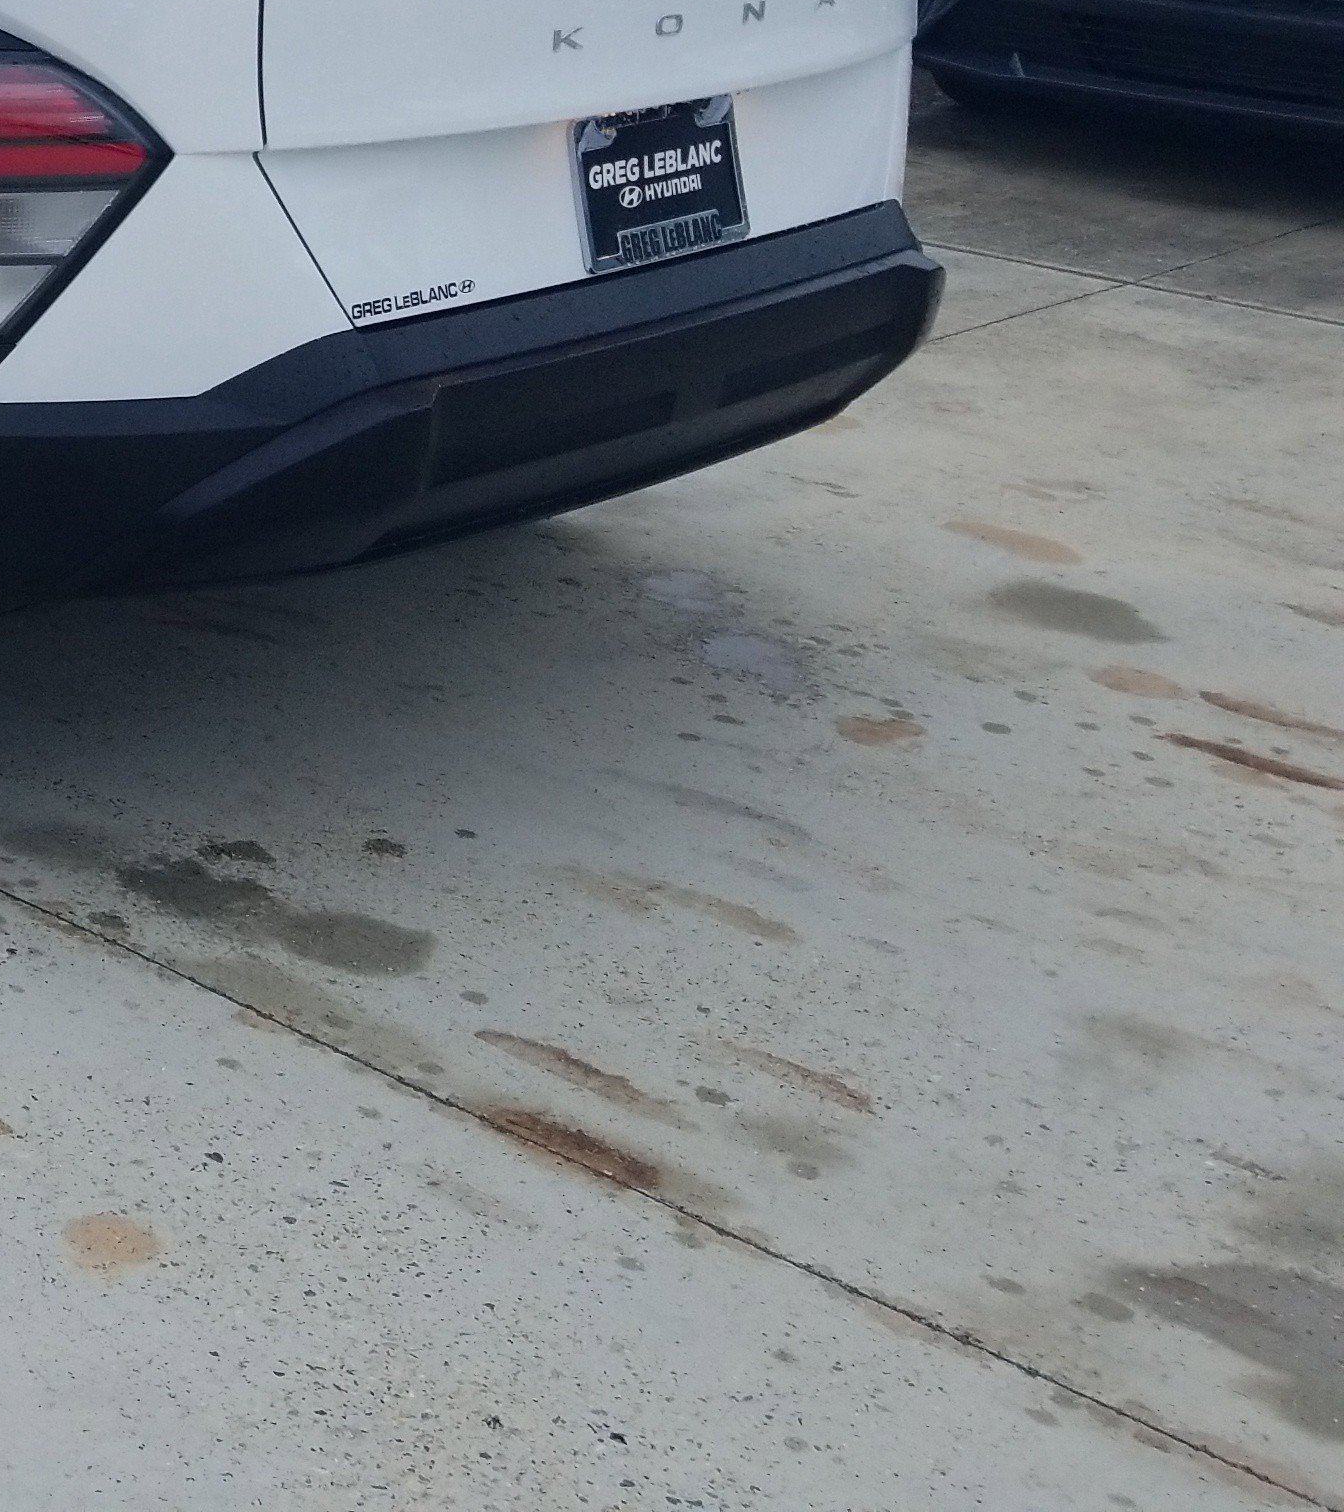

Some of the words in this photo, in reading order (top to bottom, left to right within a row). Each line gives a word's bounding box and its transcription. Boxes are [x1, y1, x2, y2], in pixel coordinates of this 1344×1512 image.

[589, 158, 640, 190] GREG
[643, 140, 722, 179] LEBLANC
[644, 173, 702, 201] HYUNDAI
[620, 228, 661, 263] GREG
[351, 297, 392, 320] GREG
